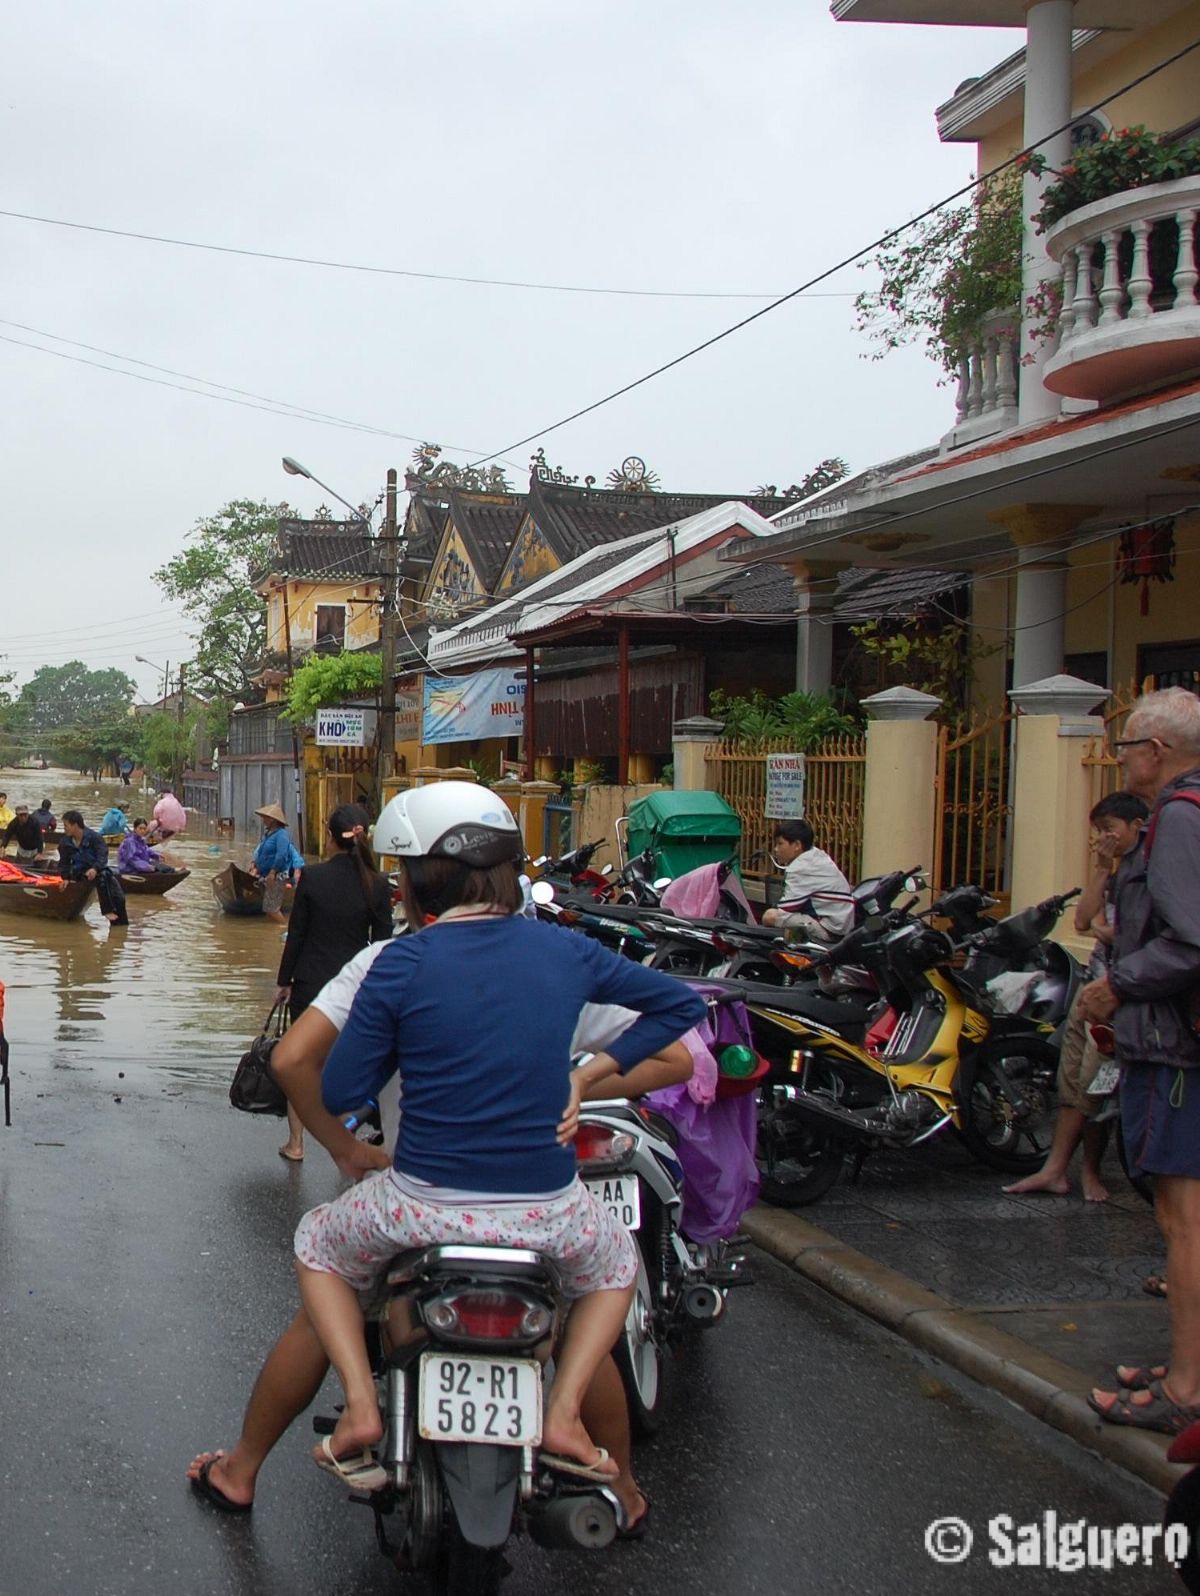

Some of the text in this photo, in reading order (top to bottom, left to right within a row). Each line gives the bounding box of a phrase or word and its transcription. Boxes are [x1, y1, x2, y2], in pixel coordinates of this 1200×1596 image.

[388, 836, 412, 851] Sport
[440, 1361, 518, 1399] 92-R1
[438, 1399, 522, 1438] 5823
